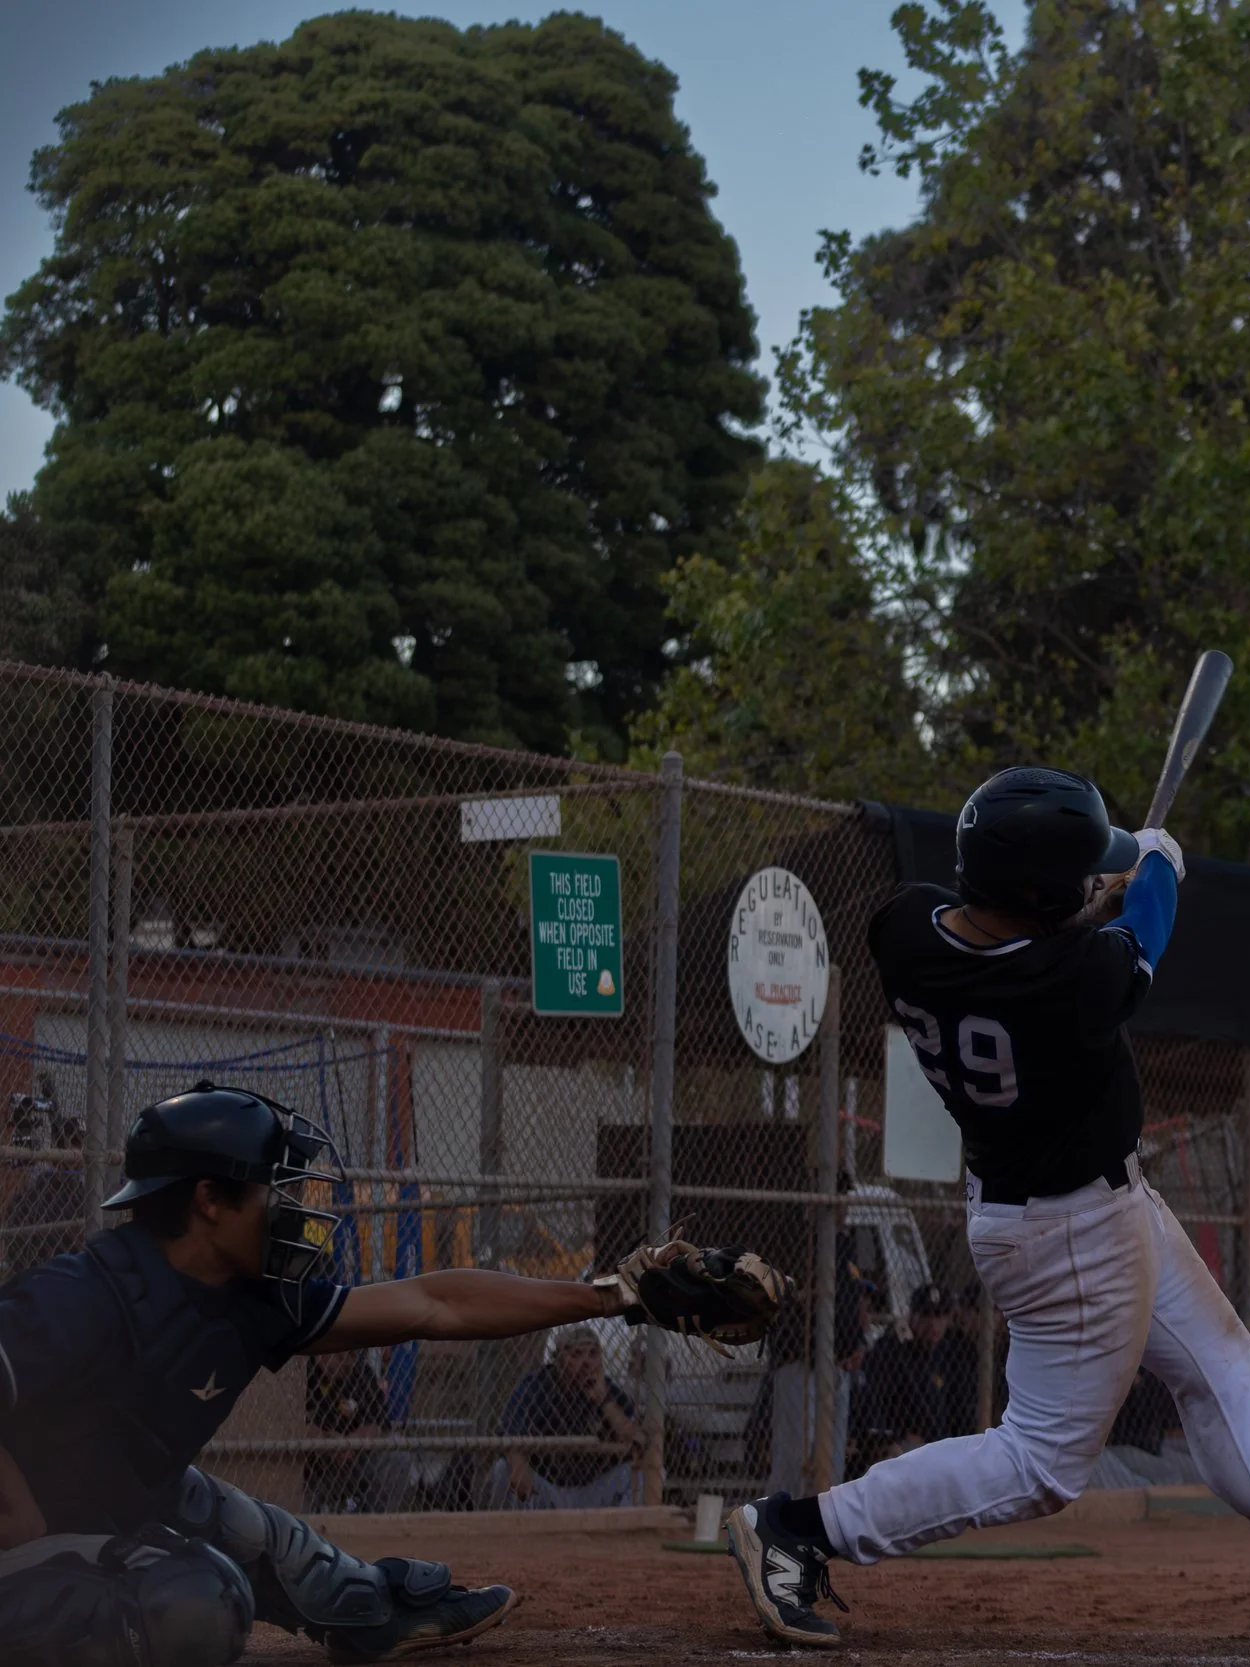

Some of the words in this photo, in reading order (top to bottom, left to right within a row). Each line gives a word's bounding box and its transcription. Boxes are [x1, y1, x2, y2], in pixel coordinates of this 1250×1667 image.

[549, 872, 571, 895] THIS
[574, 873, 601, 897] FIELD
[557, 898, 594, 921] CLOSED
[731, 871, 825, 968] REGULATION
[774, 912, 783, 927] BY
[538, 921, 566, 944] WHEN
[569, 923, 615, 947] OPPOSITE
[758, 929, 803, 949] RESERVATION
[556, 947, 584, 971] FIELD
[588, 948, 597, 971] IN
[768, 951, 786, 967] ONLY
[568, 971, 588, 995] USE
[755, 982, 766, 1001] NO
[770, 983, 802, 1002] PRACTICE
[738, 995, 819, 1058] ASEALL
[895, 997, 1020, 1108] 29
